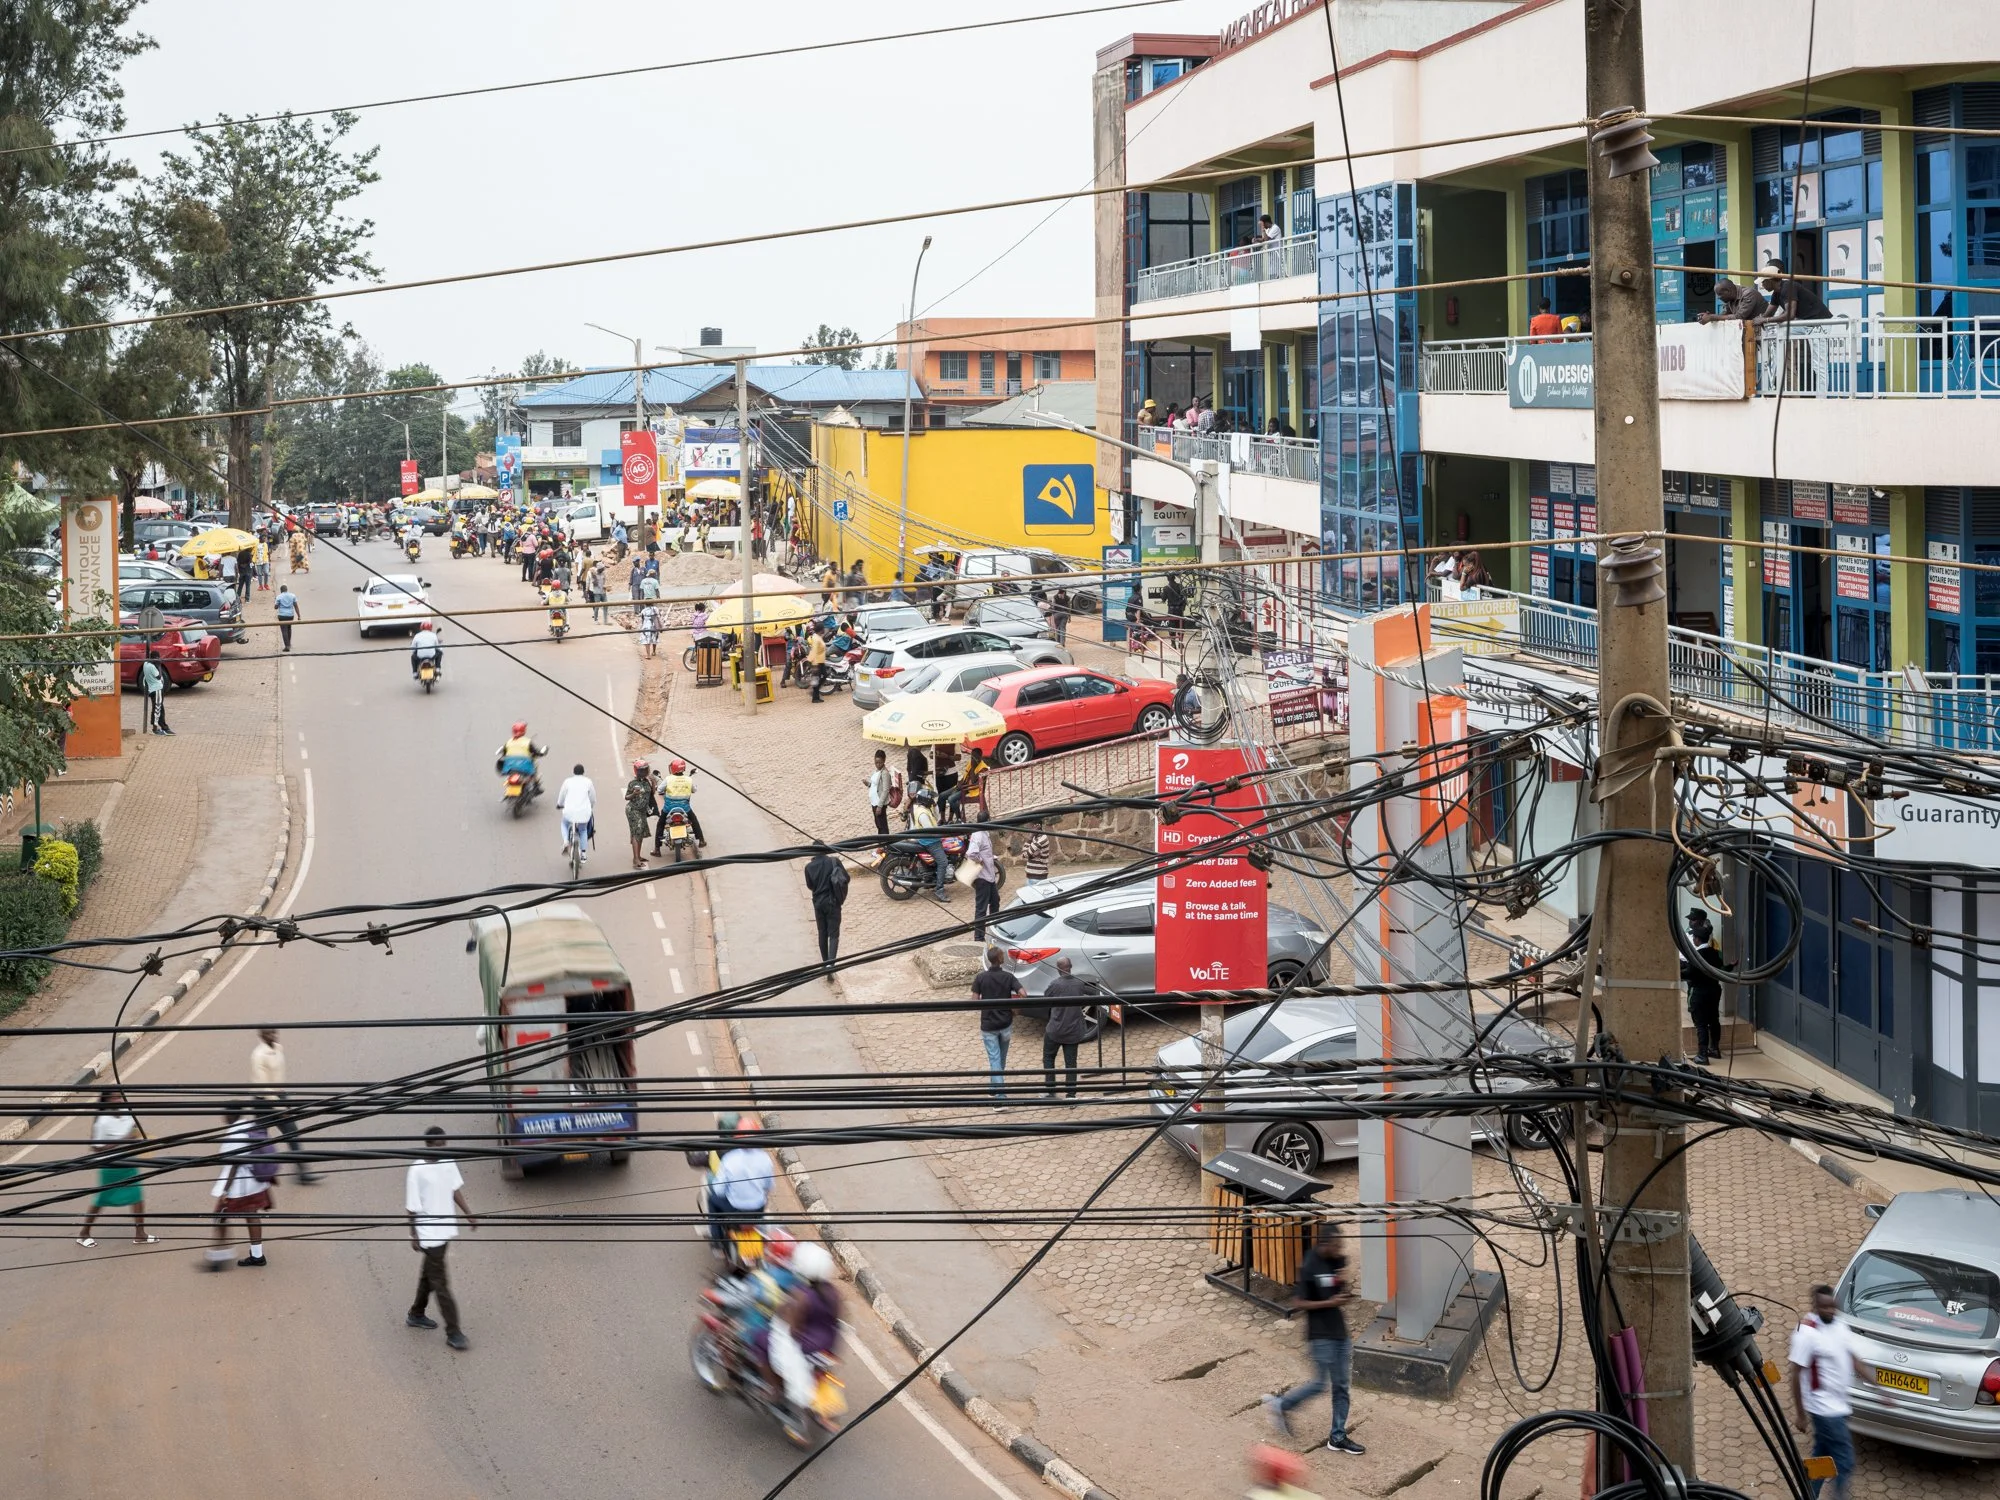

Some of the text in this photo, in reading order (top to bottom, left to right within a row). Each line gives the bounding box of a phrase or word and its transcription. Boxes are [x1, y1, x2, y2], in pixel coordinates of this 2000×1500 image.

[1540, 365, 1557, 384] INK
[632, 463, 646, 474] 4G
[837, 502, 844, 511] P
[1153, 511, 1187, 520] EQUITY
[1466, 599, 1518, 615] WIKORERA
[1268, 653, 1308, 668] AGENT
[1165, 772, 1195, 786] airtel
[1900, 804, 2000, 829] Guaranty
[1163, 831, 1181, 843] HD
[1217, 856, 1238, 866] Data
[1186, 877, 1257, 889] Zero Added fees
[1185, 901, 1247, 912] Browse & talk
[1184, 911, 1259, 921] at the same time
[1190, 967, 1230, 981] VoLTE
[523, 1111, 625, 1135] MADE IN RWANDA
[1894, 1311, 1934, 1325] Wilson
[1877, 1370, 1923, 1391] RAH646L
